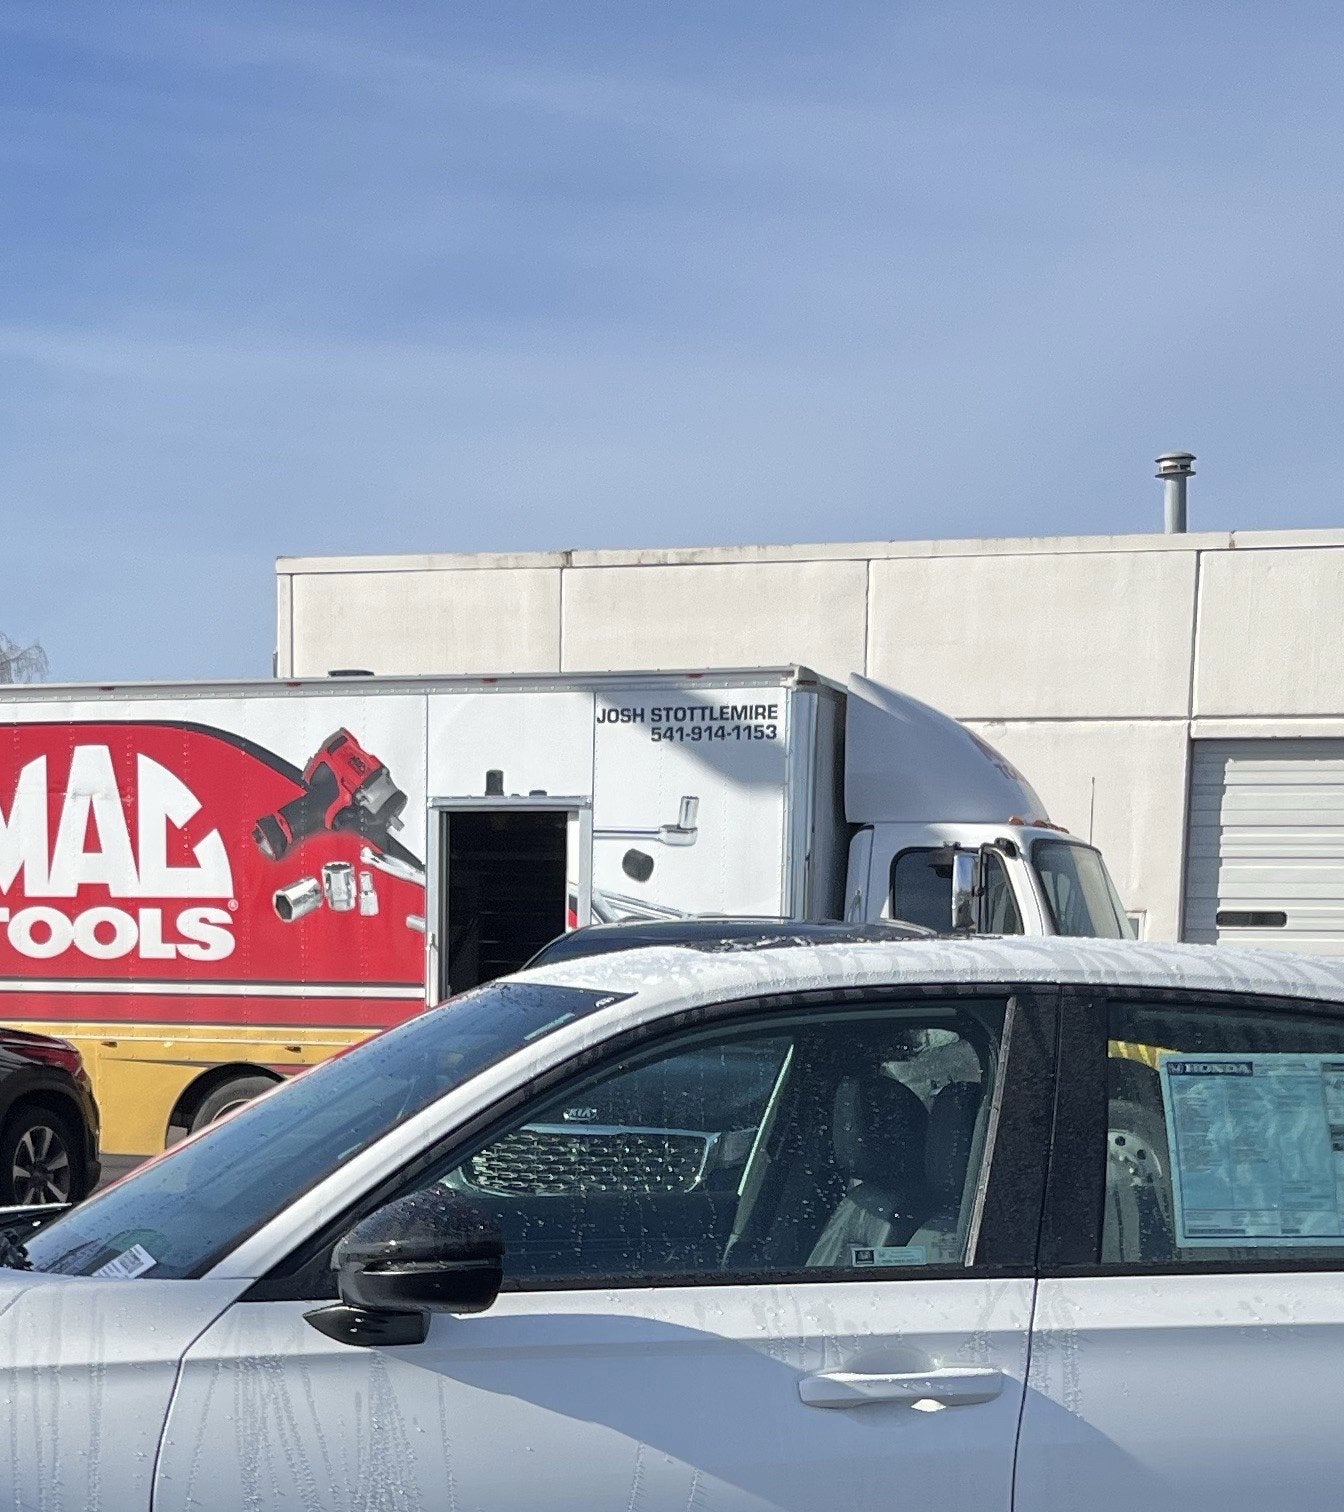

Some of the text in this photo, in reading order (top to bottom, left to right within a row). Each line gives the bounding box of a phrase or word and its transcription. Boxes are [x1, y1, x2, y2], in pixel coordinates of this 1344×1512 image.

[597, 704, 778, 723] JOSH STOTTLEMIRE
[651, 725, 777, 741] 541-914-1153
